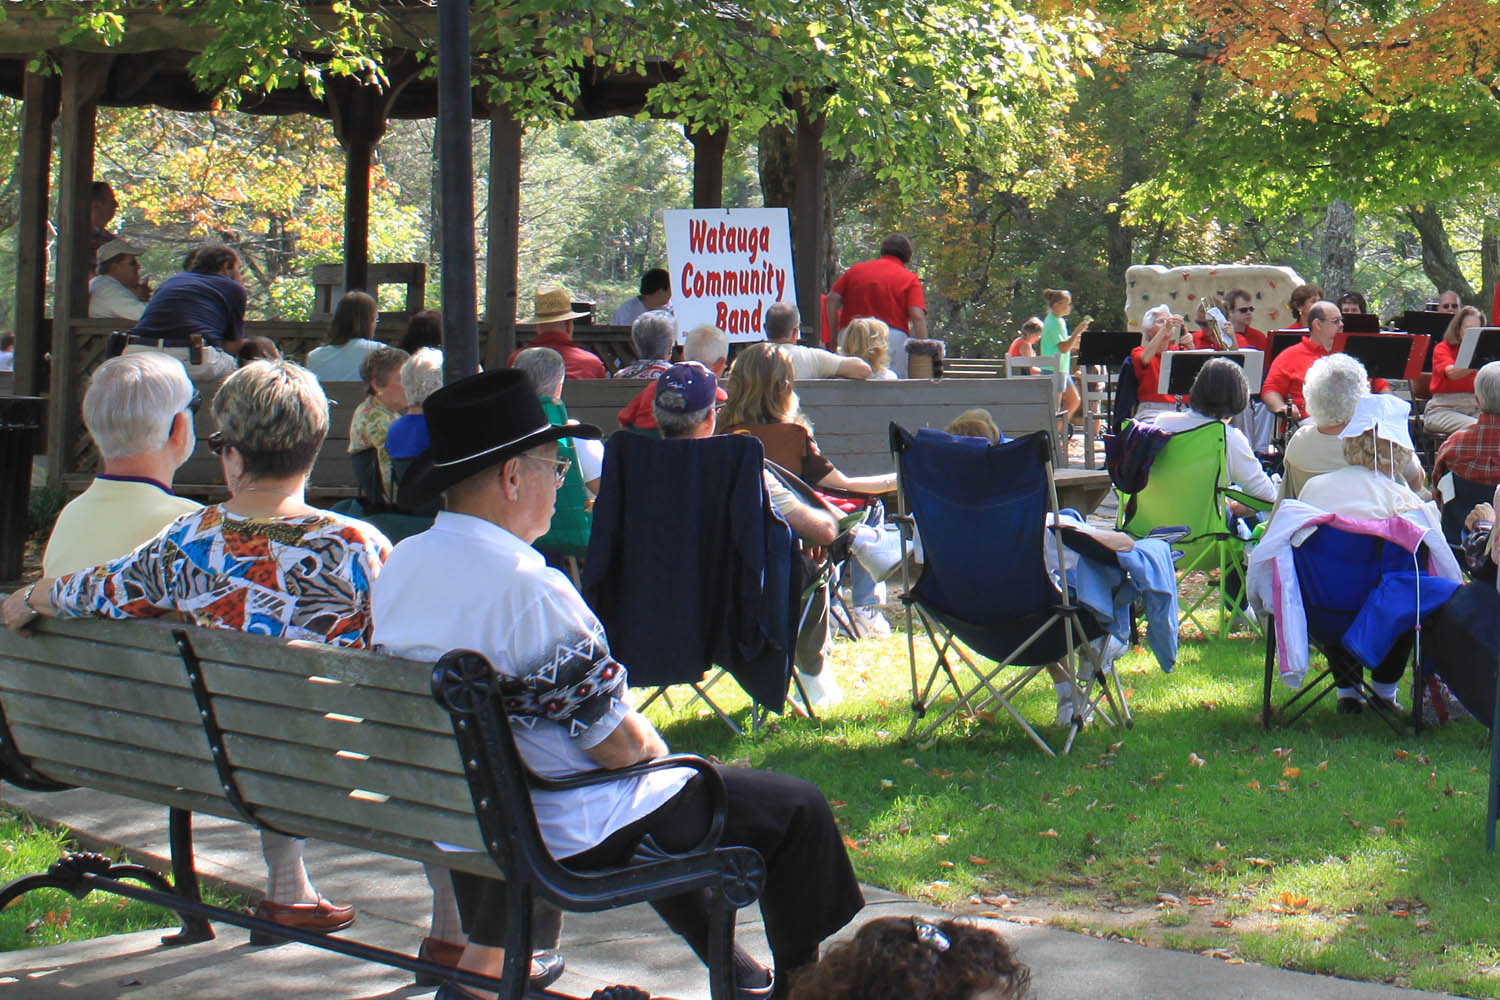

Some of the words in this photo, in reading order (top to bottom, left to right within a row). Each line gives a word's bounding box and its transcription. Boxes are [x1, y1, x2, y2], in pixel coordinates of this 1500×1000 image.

[690, 219, 770, 264] Watauga
[682, 260, 785, 302] Community
[716, 299, 762, 334] Band
